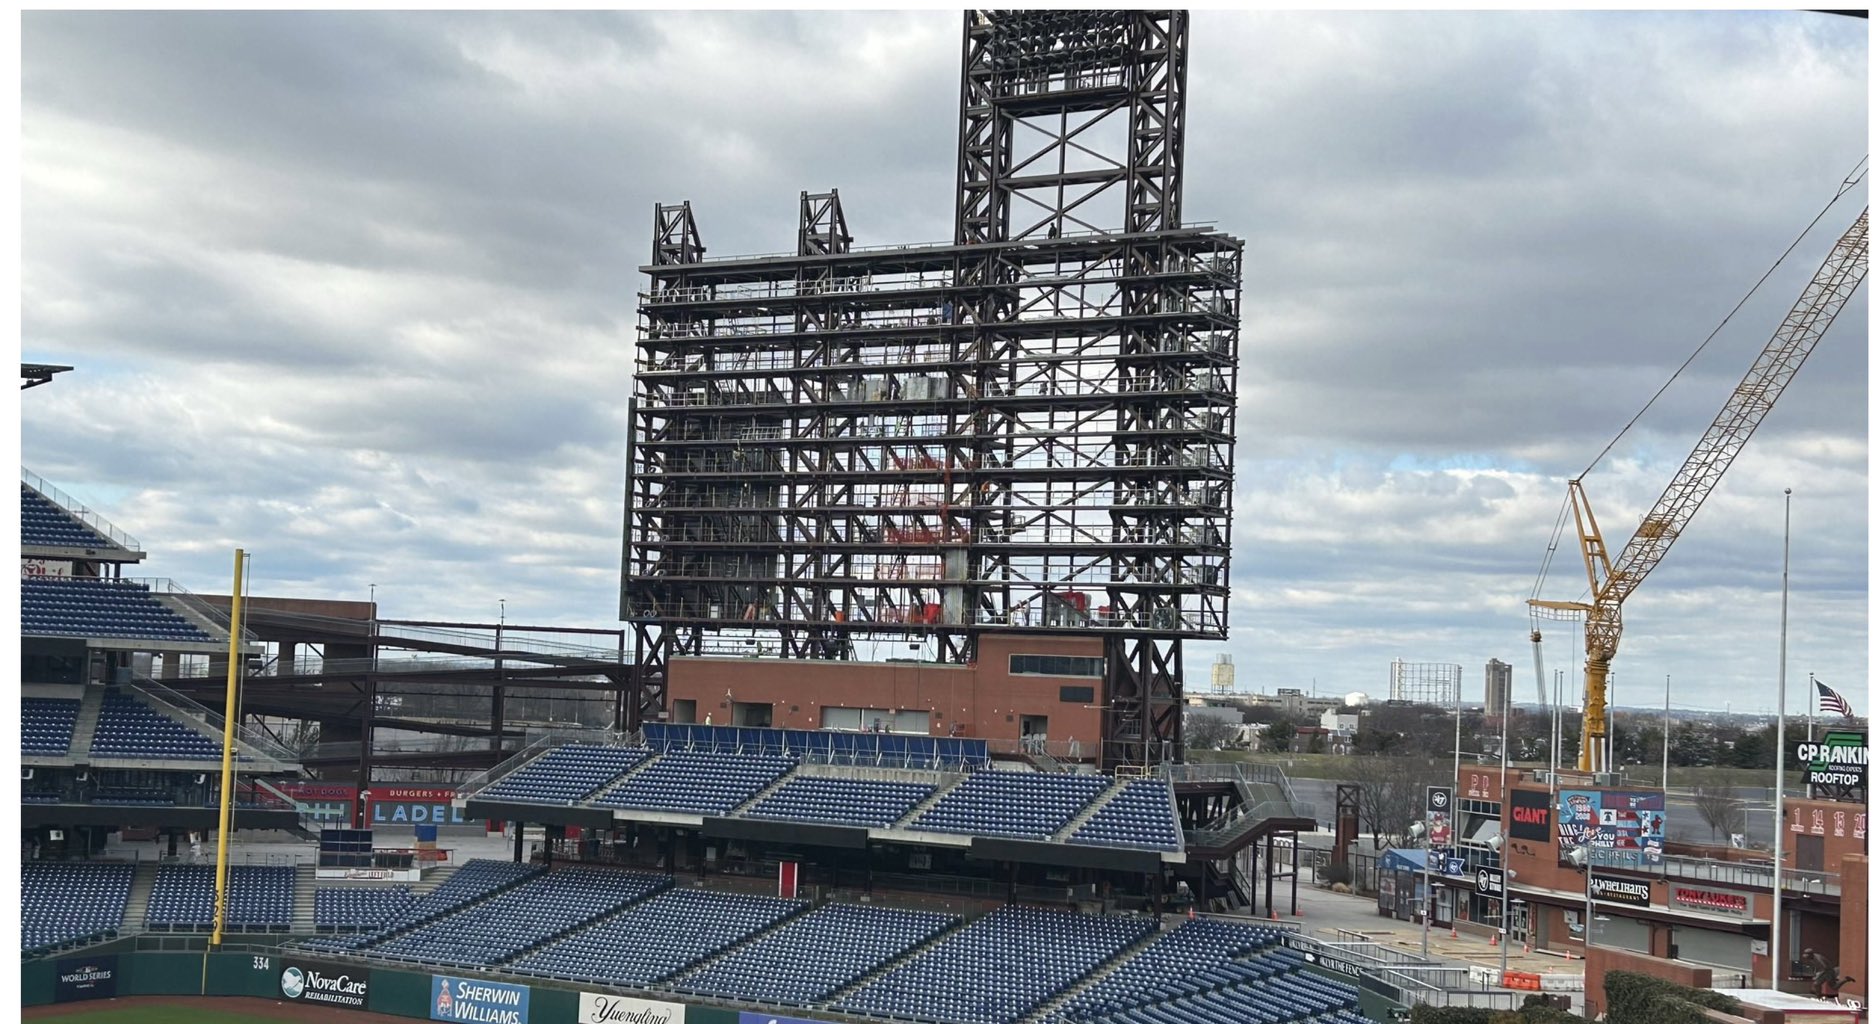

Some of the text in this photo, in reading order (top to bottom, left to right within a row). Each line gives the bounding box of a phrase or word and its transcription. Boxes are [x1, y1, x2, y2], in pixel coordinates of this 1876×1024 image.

[1797, 743, 1818, 762] CP
[1810, 772, 1859, 785] ROOFTOP
[389, 789, 434, 798] BURGERS
[1512, 806, 1548, 824] GIANT
[1794, 807, 1800, 826] 1
[1812, 808, 1824, 827] 14
[253, 955, 269, 970] 334
[61, 970, 111, 983] WORLD SERIES
[304, 970, 367, 995] NovaCare
[304, 991, 364, 1005] REHABILITATION
[456, 981, 521, 1006] SHERWIN
